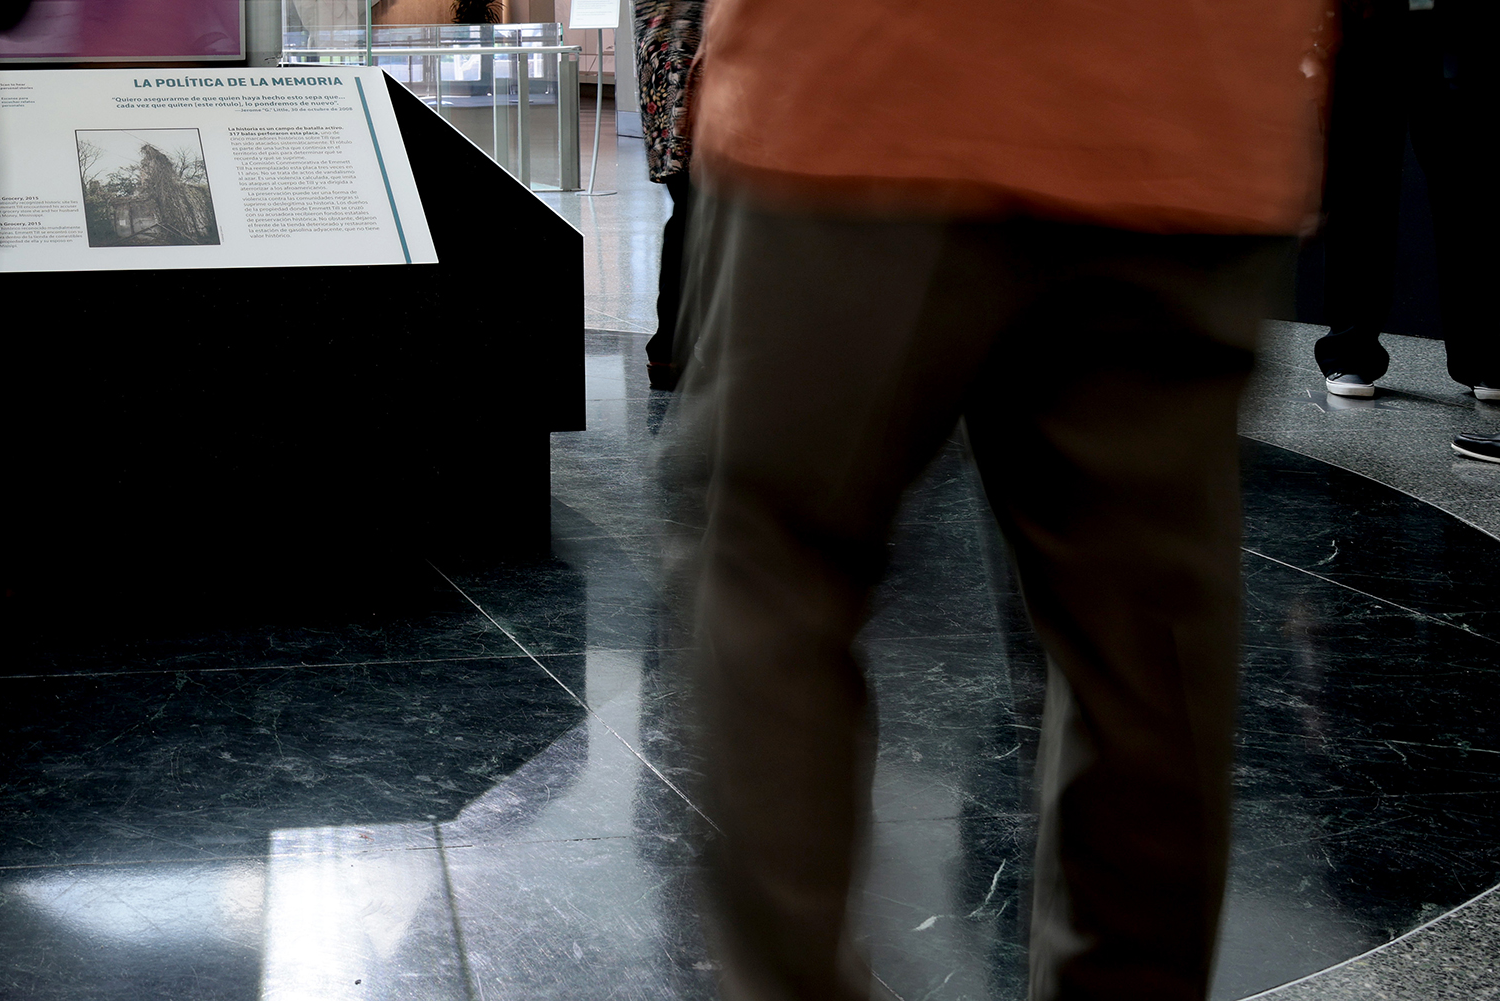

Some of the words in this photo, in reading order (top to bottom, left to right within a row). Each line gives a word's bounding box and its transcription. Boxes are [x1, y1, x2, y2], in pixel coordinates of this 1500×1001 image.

[133, 78, 152, 88] LA
[155, 76, 225, 87] POLÍTICA
[227, 77, 247, 87] DE
[250, 77, 269, 86] LA
[271, 76, 343, 86] MEMORIA
